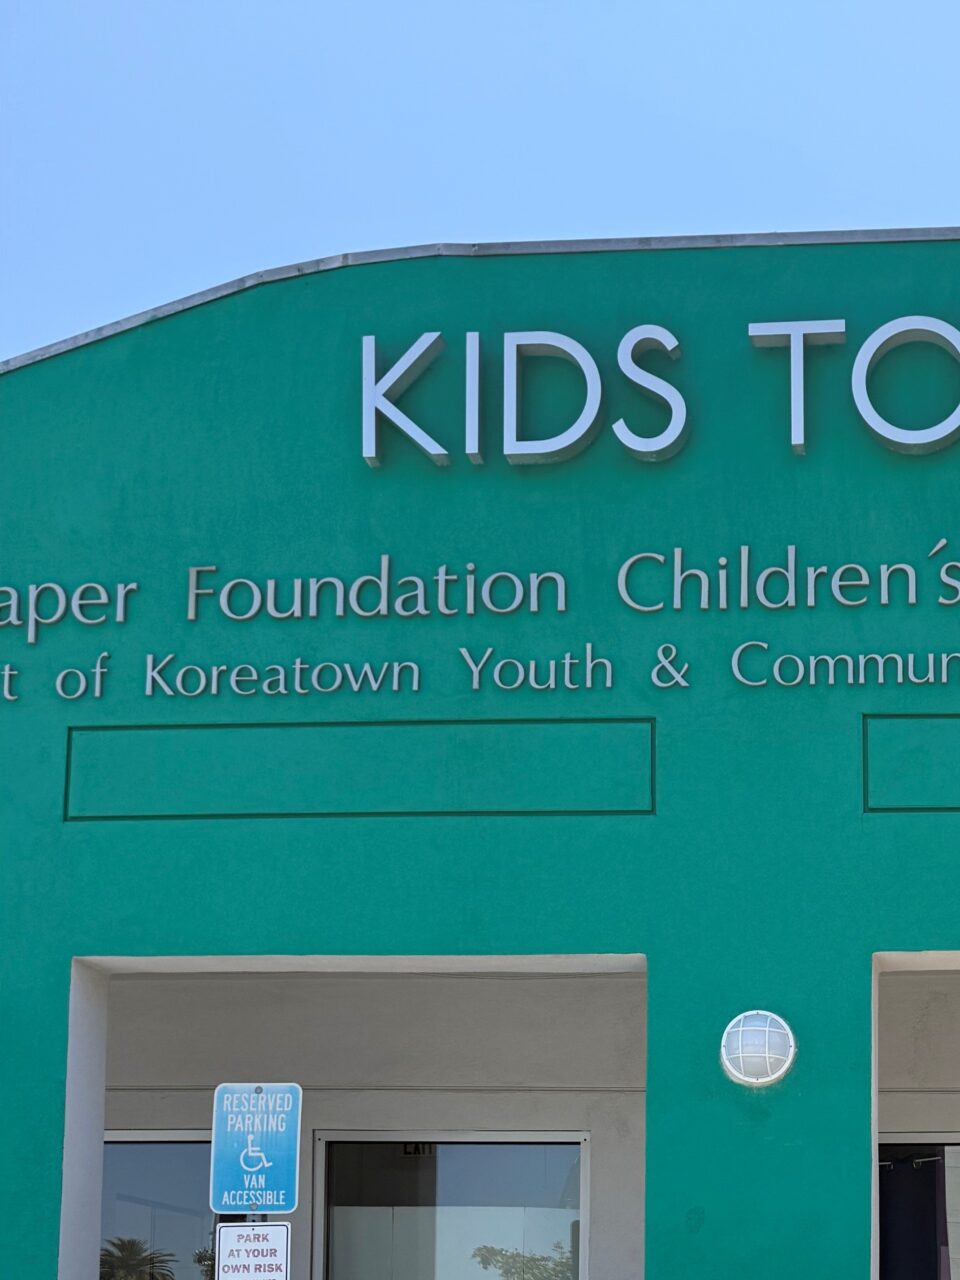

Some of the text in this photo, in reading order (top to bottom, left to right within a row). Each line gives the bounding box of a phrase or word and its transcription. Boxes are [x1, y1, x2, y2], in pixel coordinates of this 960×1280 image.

[361, 323, 689, 467] KIDS
[187, 553, 567, 621] Foundation
[55, 651, 110, 699] of
[145, 653, 421, 696] Koreatown
[459, 642, 613, 690] Youth
[650, 643, 690, 688] &
[223, 1093, 292, 1112] RESERVED
[227, 1114, 287, 1132] PARKING
[243, 1174, 265, 1188] VAN
[222, 1191, 286, 1205] ACCESSIBLE
[236, 1233, 270, 1243] PARK
[227, 1248, 278, 1258] AT YOUR
[222, 1263, 283, 1273] OWN RISK
